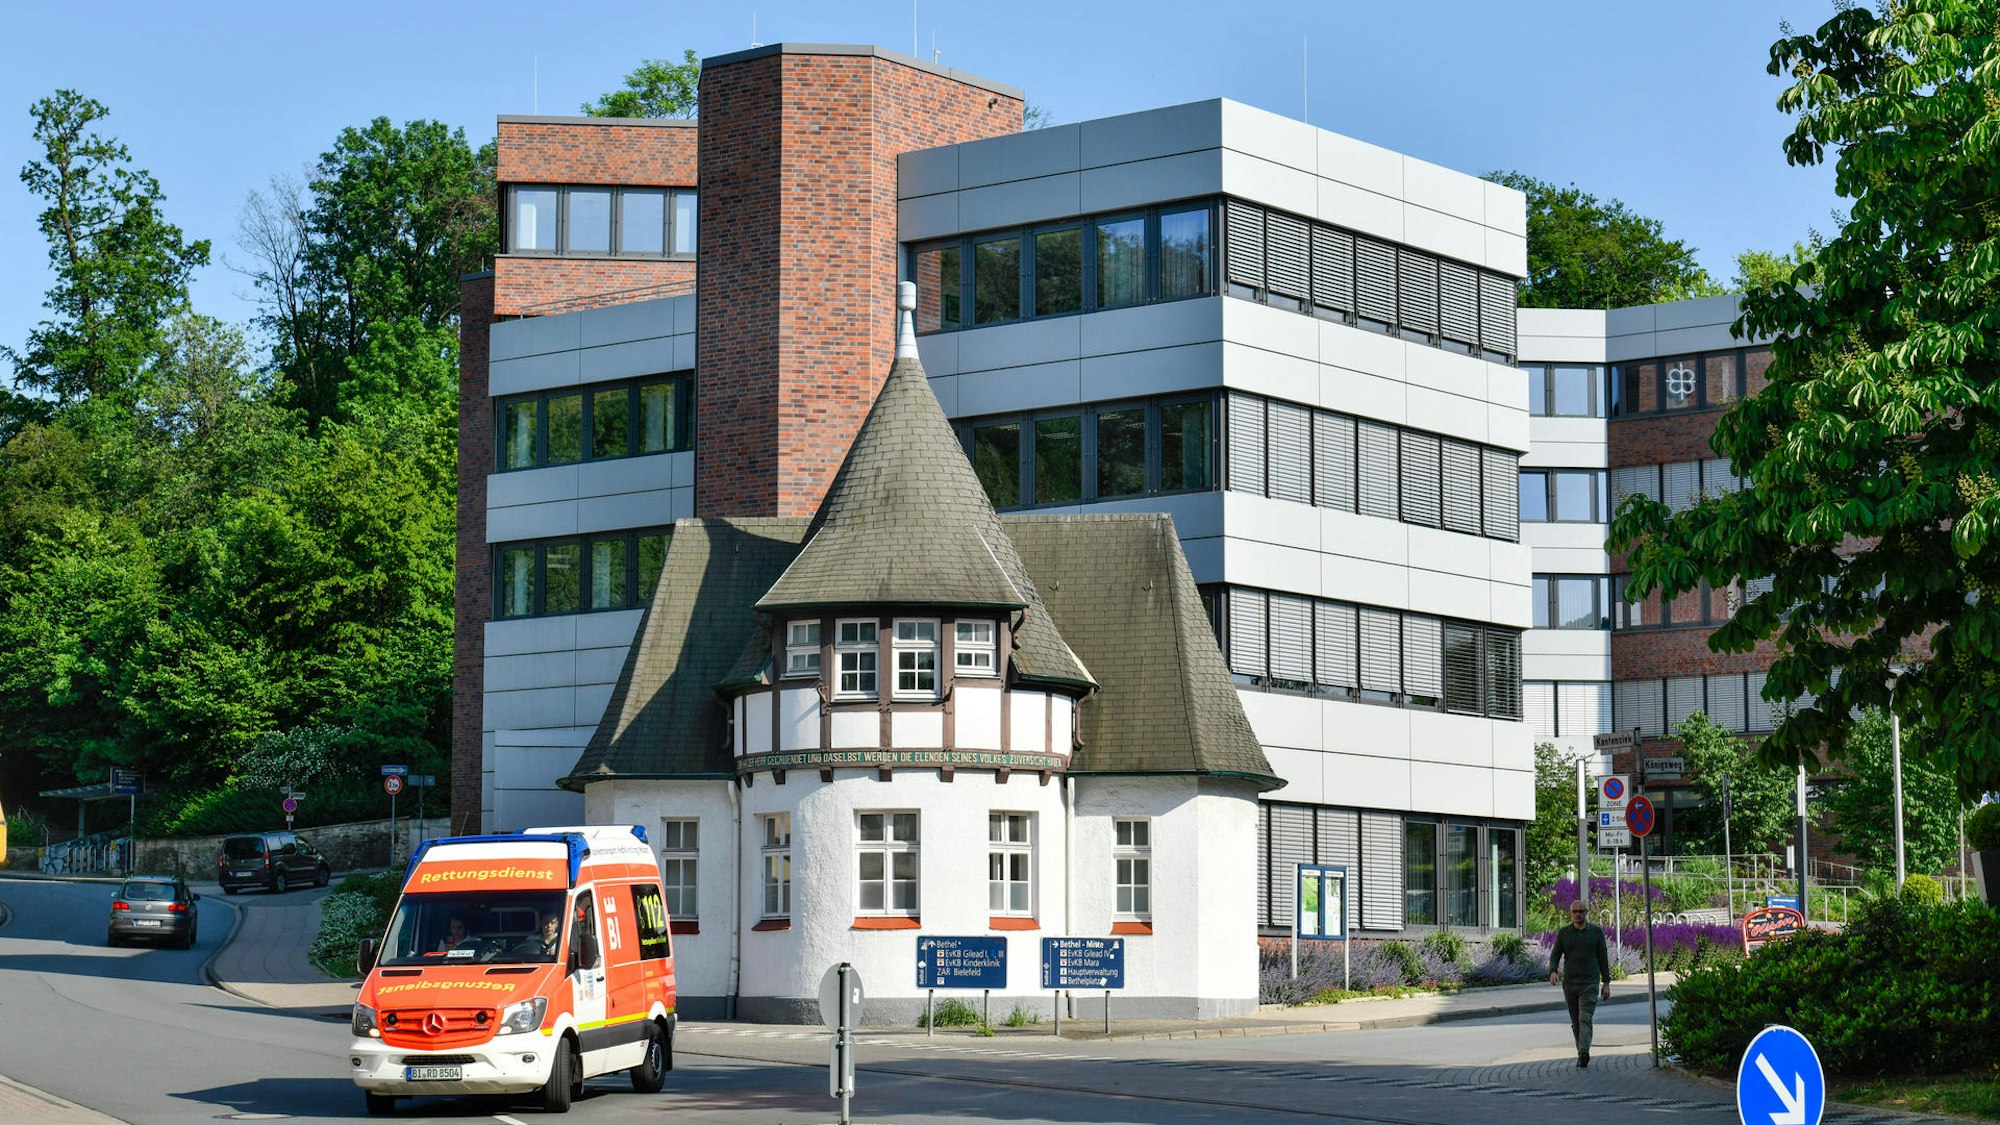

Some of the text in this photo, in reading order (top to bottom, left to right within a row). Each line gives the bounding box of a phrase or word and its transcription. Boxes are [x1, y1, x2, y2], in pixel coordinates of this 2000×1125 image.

[1596, 734, 1632, 746] Kantensiek
[823, 752, 861, 763] DASELBST
[864, 752, 897, 762] WERDEN
[900, 752, 912, 762] DIE
[915, 752, 948, 763] ELENDEN
[951, 752, 977, 763] SEINES
[980, 753, 1006, 764] VOLKES
[1010, 754, 1046, 767] ZUVERSICHT
[421, 867, 553, 884] Rettungsdienst
[641, 894, 664, 929] 112
[937, 940, 957, 948] Bethel
[1060, 940, 1081, 948] Bethel
[1086, 940, 1104, 948] Mitte
[945, 950, 961, 958] EvKB
[963, 949, 984, 958] Gilead
[1084, 949, 1102, 958] Gilead
[945, 958, 1000, 967] EvKB Kinderklinik
[937, 968, 981, 976] ZAR Bielefeld
[1068, 968, 1118, 978] Hauptverwaltung
[412, 1068, 459, 1078] BI RD 8504
